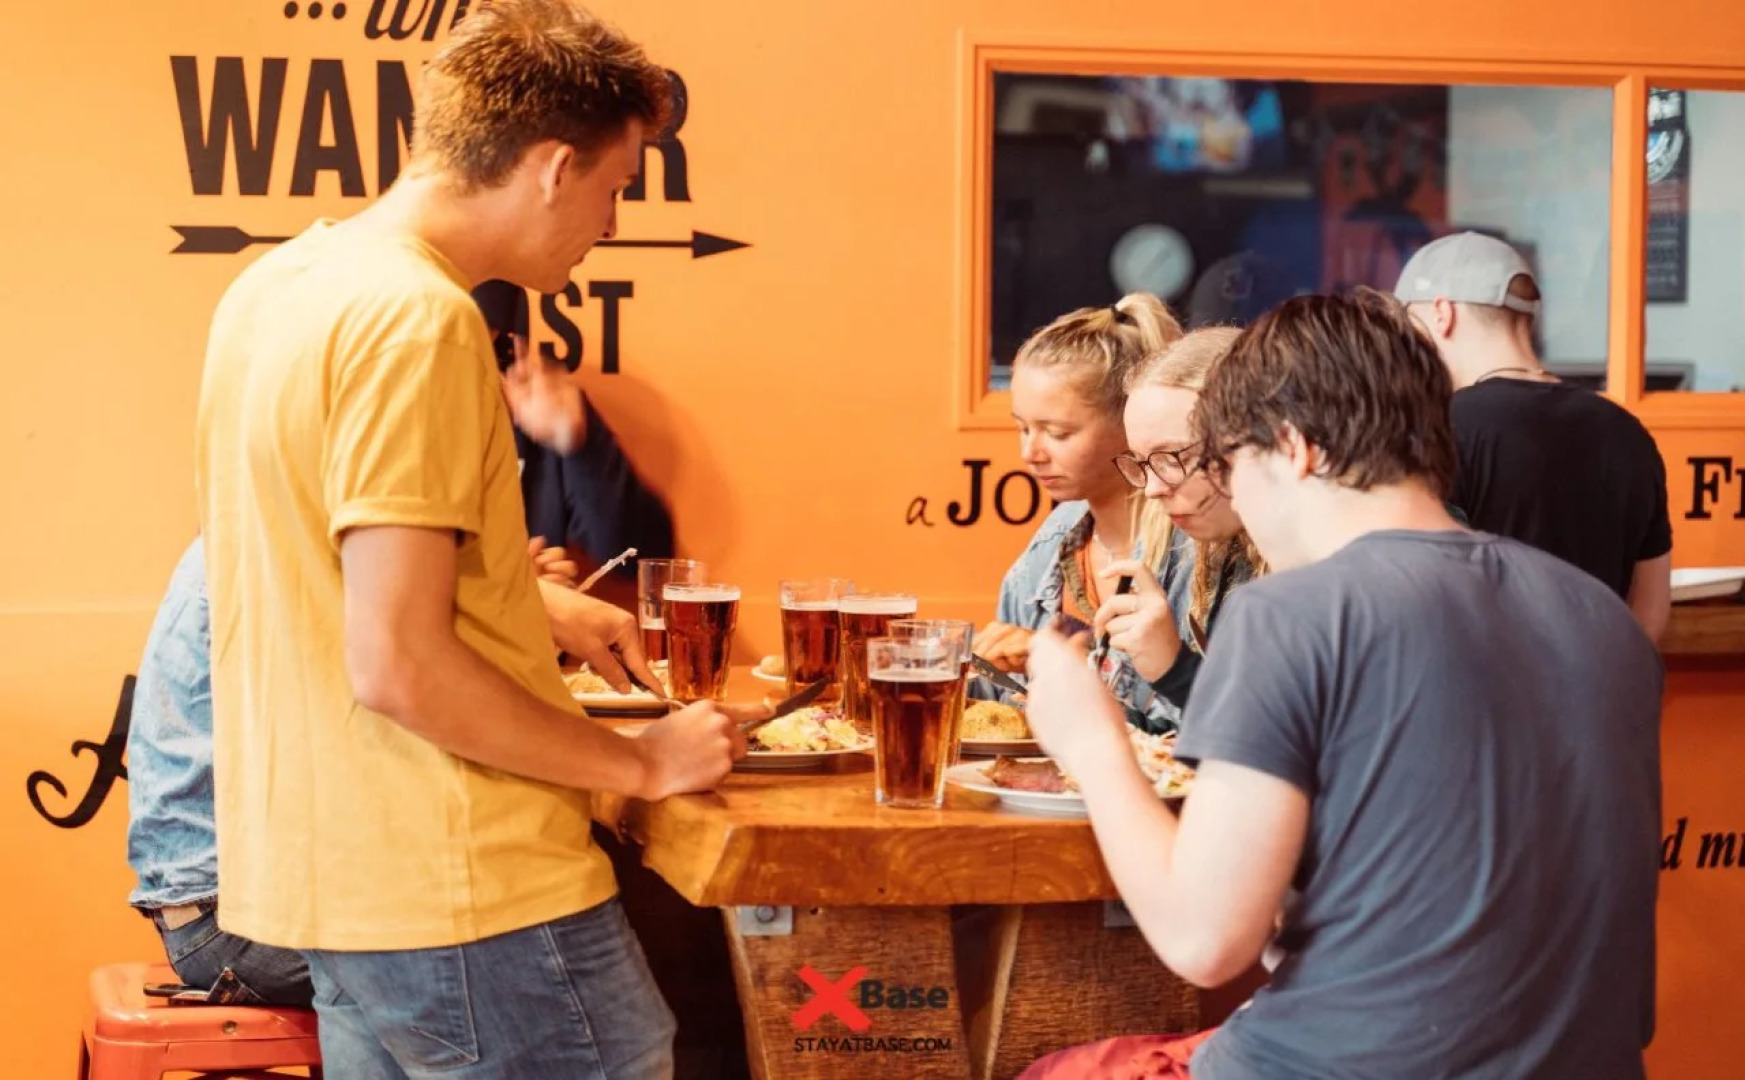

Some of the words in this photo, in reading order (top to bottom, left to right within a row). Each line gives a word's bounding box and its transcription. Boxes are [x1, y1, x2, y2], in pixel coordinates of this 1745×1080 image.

[170, 55, 692, 202] WANR
[512, 279, 634, 374] ST
[905, 495, 935, 528] a
